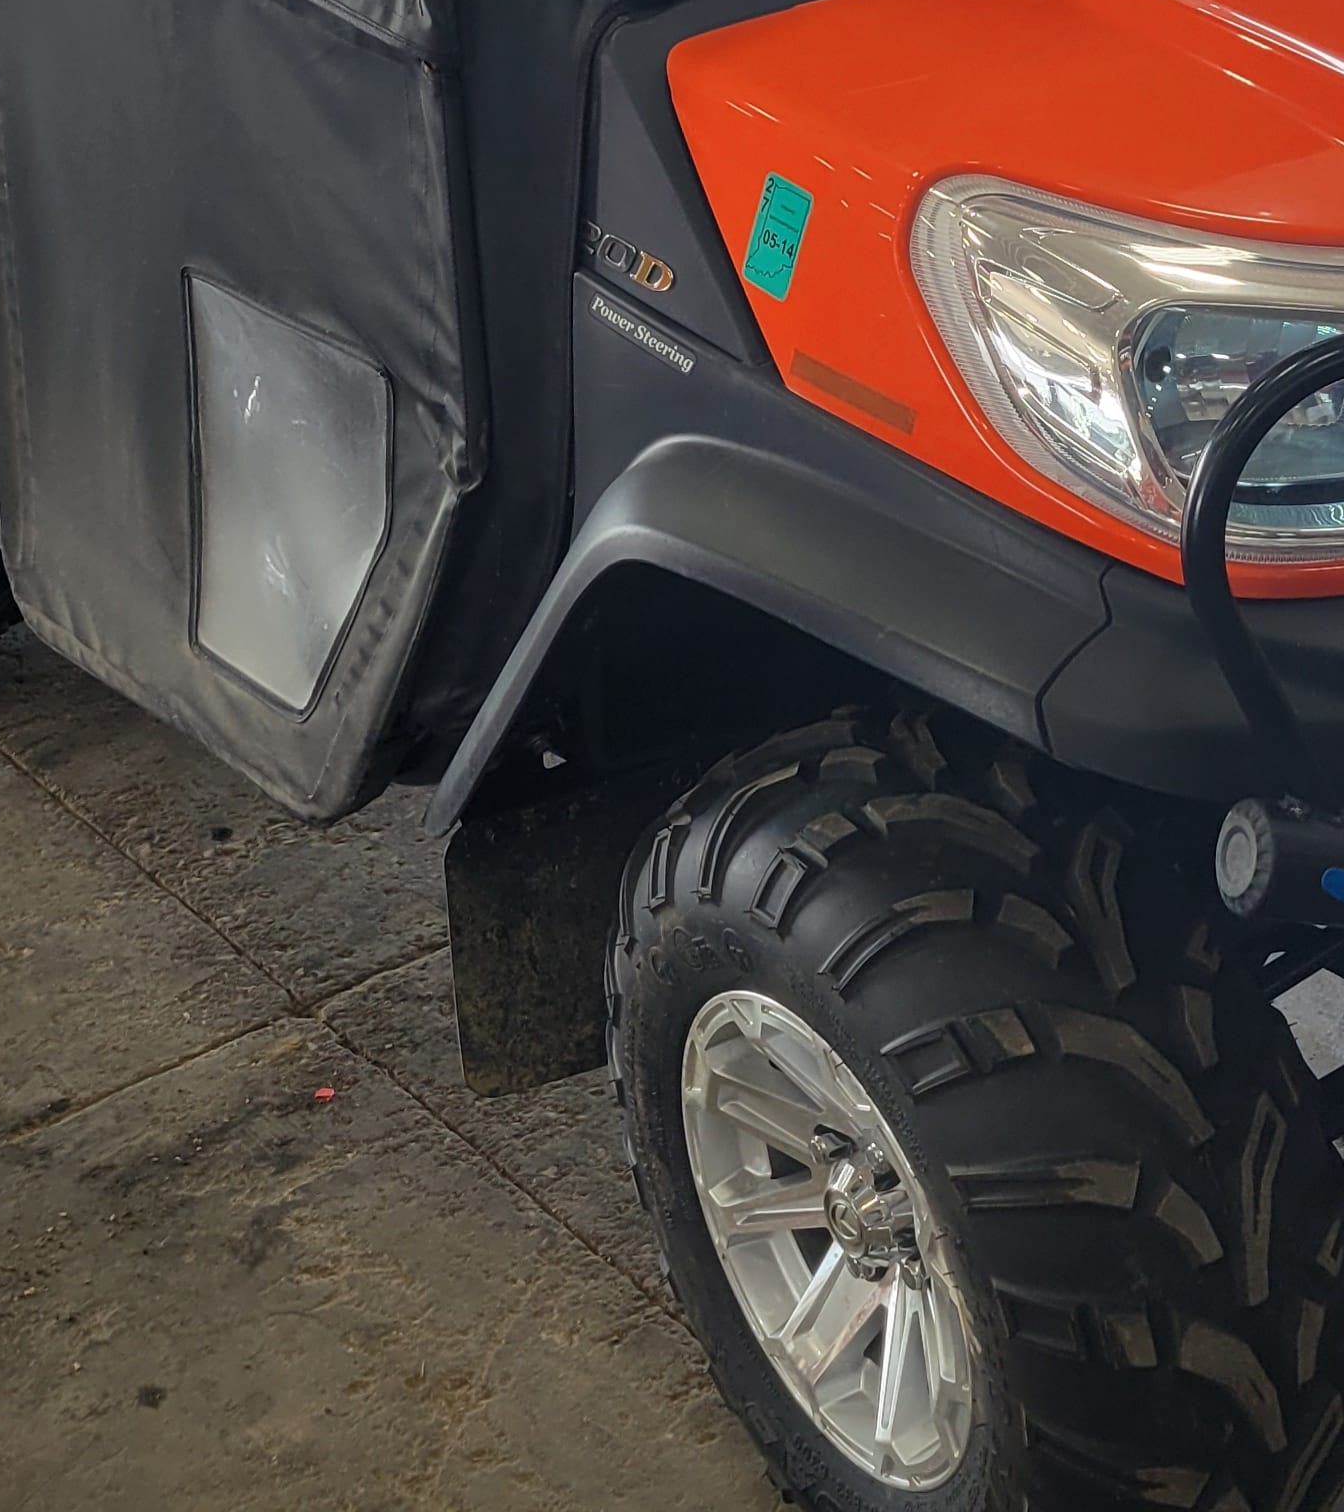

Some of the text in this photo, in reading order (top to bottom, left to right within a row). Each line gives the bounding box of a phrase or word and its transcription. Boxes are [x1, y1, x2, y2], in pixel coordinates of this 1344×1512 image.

[763, 229, 795, 258] 05-14
[591, 296, 694, 374] Power Steering
